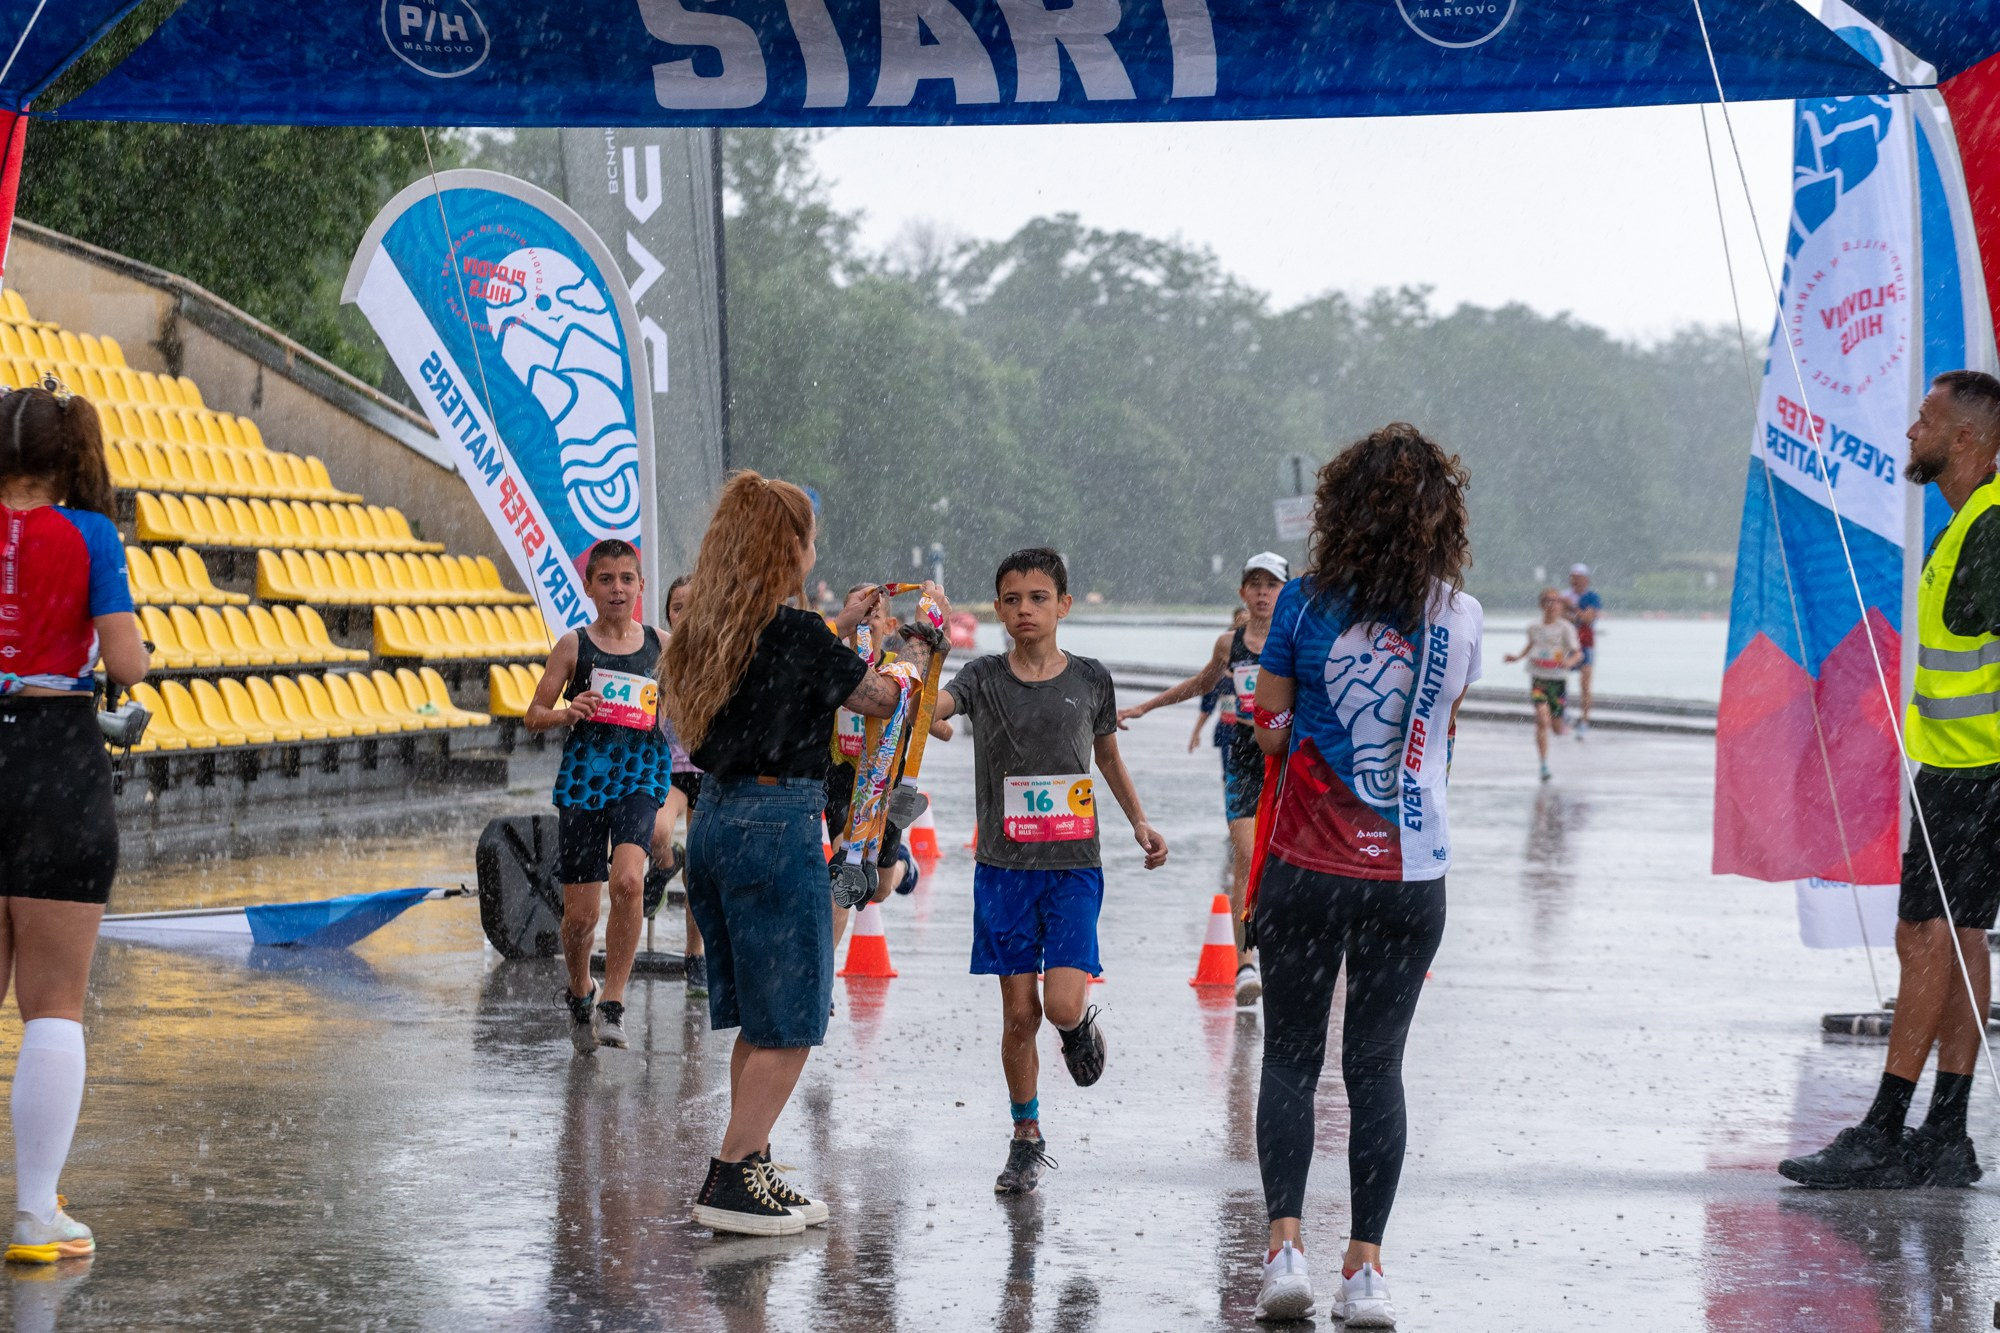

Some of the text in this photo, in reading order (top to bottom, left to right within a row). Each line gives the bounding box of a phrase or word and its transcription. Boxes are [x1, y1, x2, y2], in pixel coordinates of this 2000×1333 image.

[1420, 4, 1497, 18] MARKOVO
[398, 4, 469, 42] P/H
[403, 42, 474, 53] MARKOVO
[1384, 641, 1407, 658] HILLS
[602, 681, 631, 702] 64
[1402, 623, 1450, 832] EVERY STEP MATTERS
[1023, 789, 1054, 812] 16
